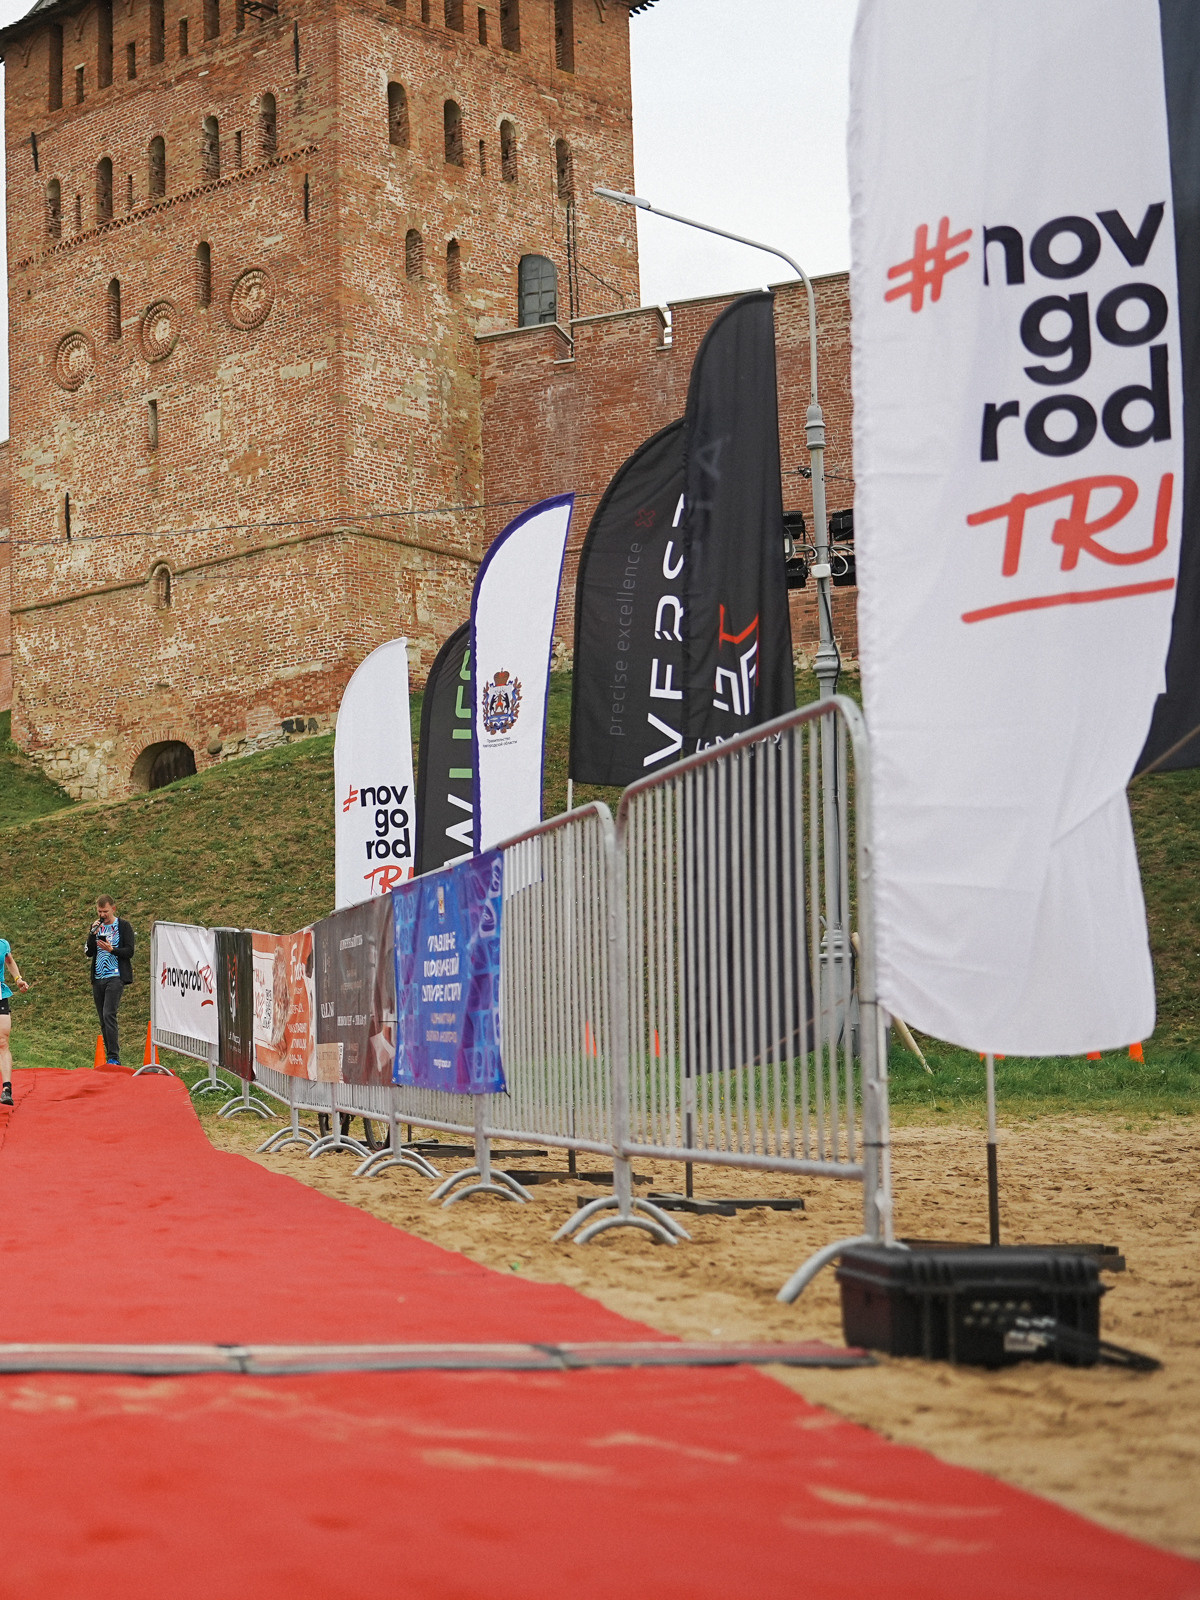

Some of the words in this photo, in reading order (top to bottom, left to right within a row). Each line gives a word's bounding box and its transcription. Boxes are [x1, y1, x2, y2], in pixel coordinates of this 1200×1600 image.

[884, 201, 1165, 313] #nov
[1020, 282, 1168, 386] go
[980, 343, 1172, 462] rod
[966, 472, 1174, 577] TRI
[616, 542, 642, 651] excellence
[609, 660, 628, 736] precise
[343, 784, 408, 812] #nov
[366, 828, 411, 859] rod
[375, 808, 409, 837] go
